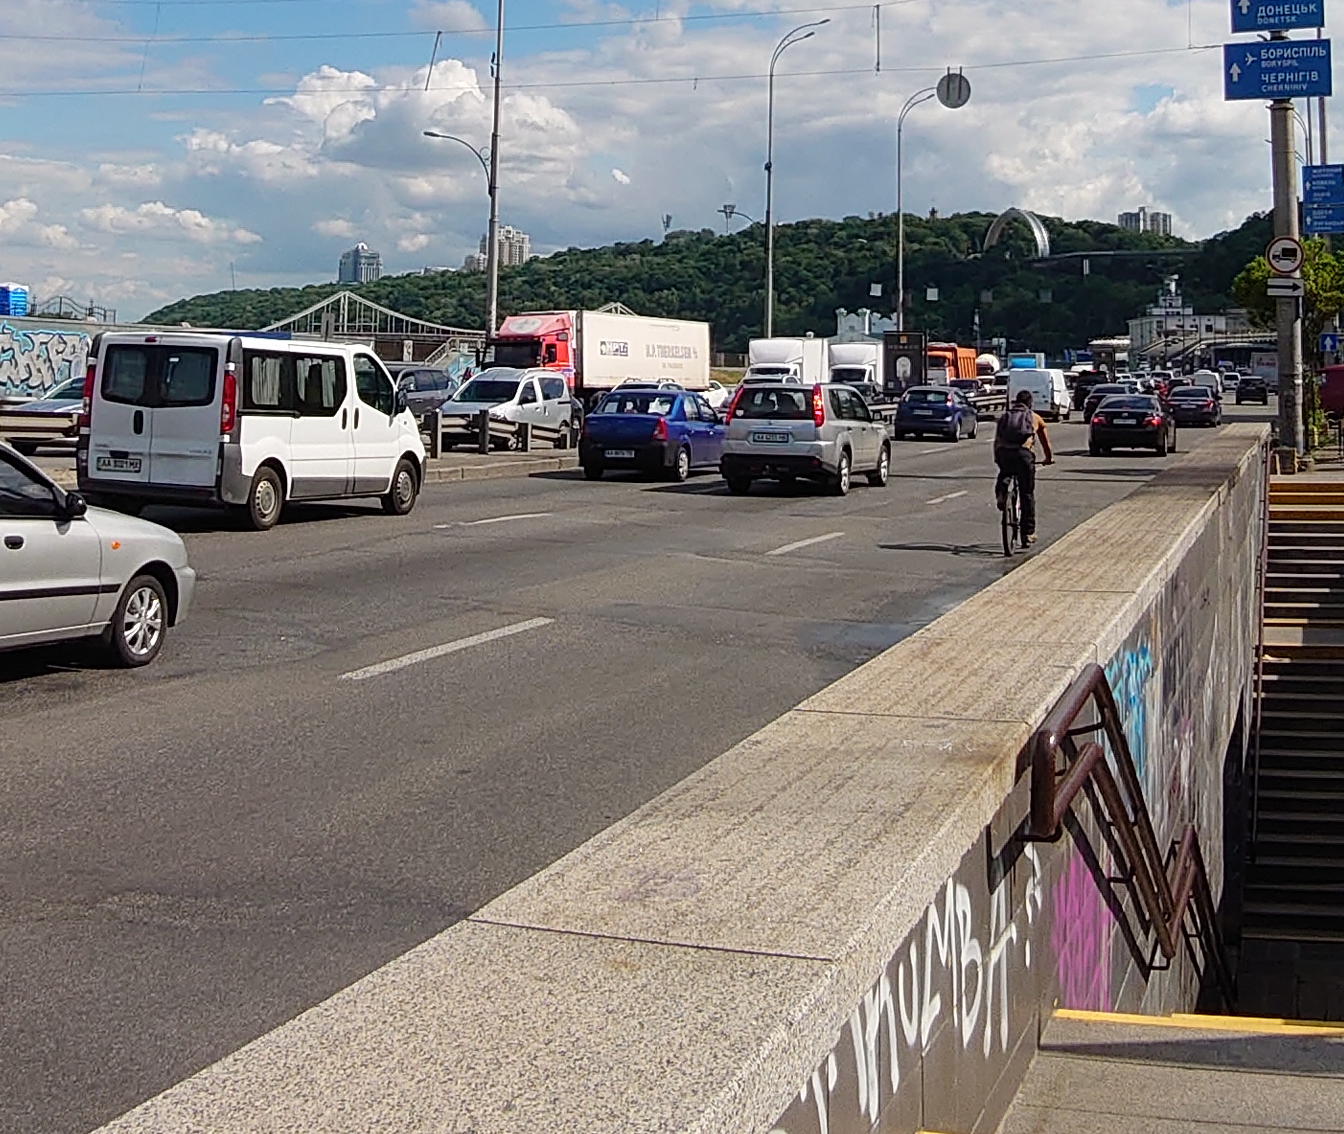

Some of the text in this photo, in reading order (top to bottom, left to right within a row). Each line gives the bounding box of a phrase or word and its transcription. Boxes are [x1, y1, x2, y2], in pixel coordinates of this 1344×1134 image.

[1257, 3, 1318, 17] ДОНЕЦЬК
[1257, 16, 1297, 24] DONETSK
[1260, 47, 1327, 59] БОРИСПІЛЬ
[1261, 59, 1299, 67] BORYSPIL
[1261, 71, 1319, 83] ЧЕРНІГІВ
